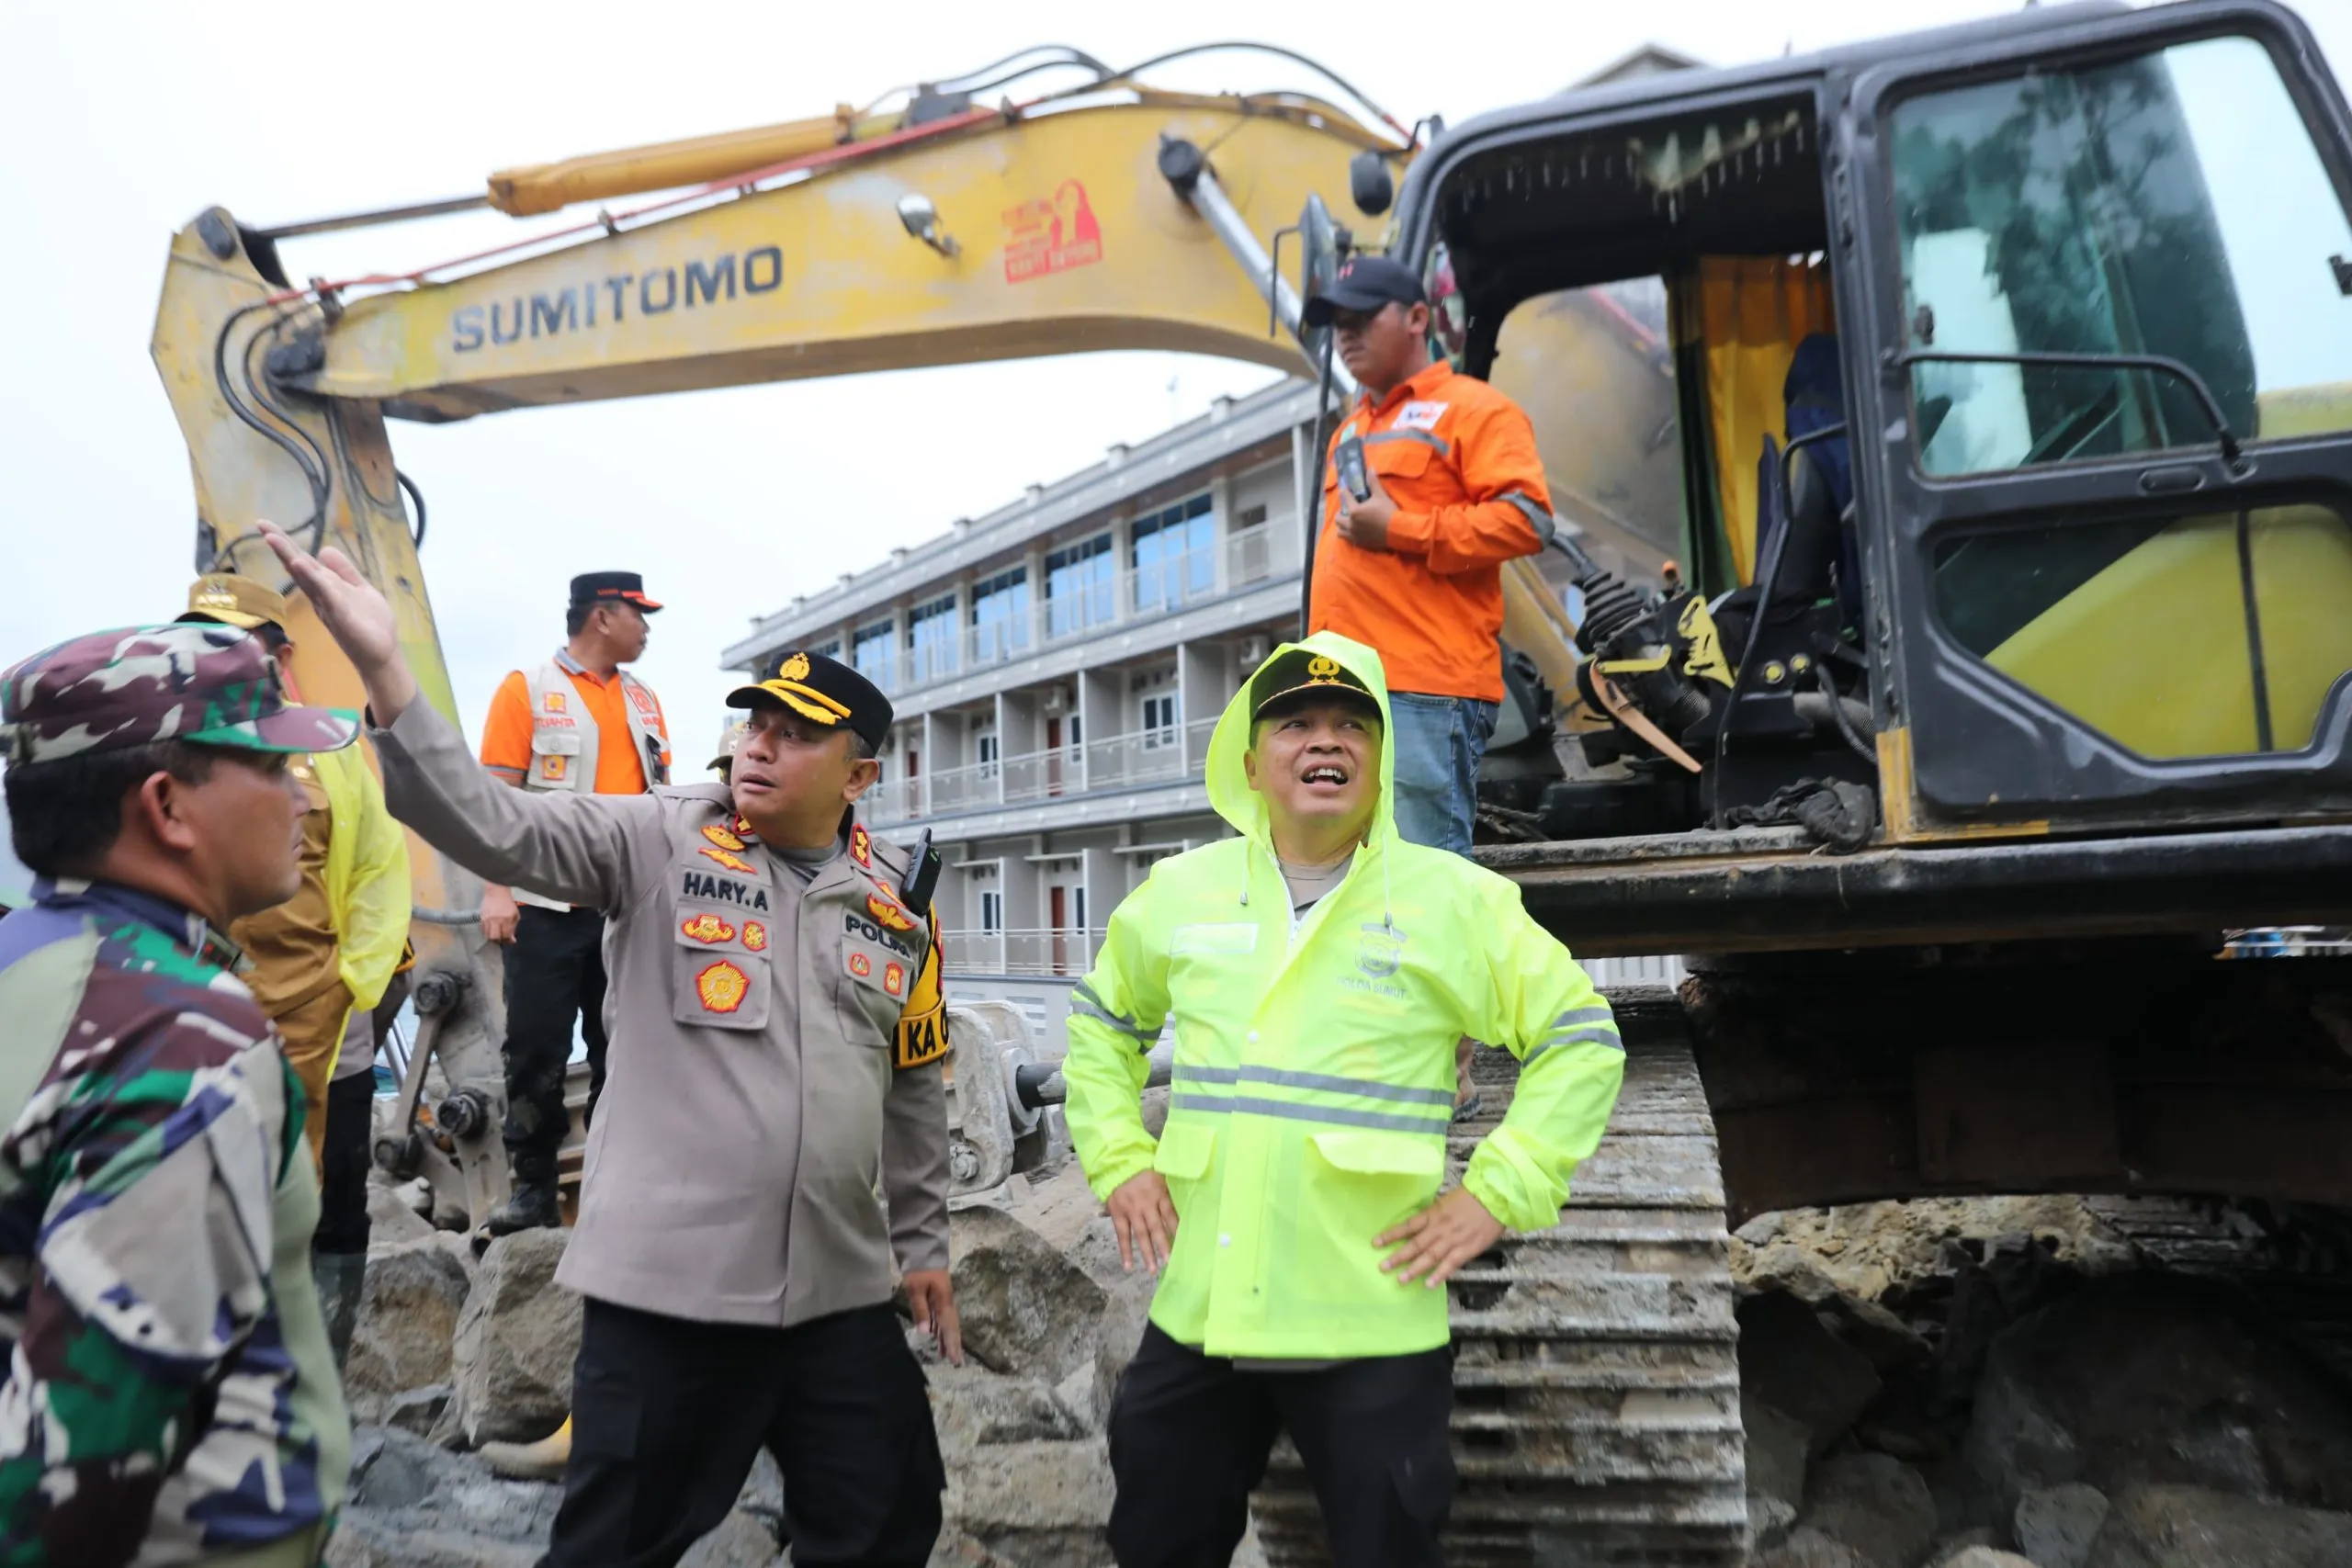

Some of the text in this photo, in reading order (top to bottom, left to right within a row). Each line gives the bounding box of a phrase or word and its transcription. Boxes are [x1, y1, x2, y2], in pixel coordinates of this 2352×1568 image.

[453, 244, 783, 353] SUMITOMO
[1373, 984, 1407, 998] SUMUT
[908, 1017, 936, 1060] KA
